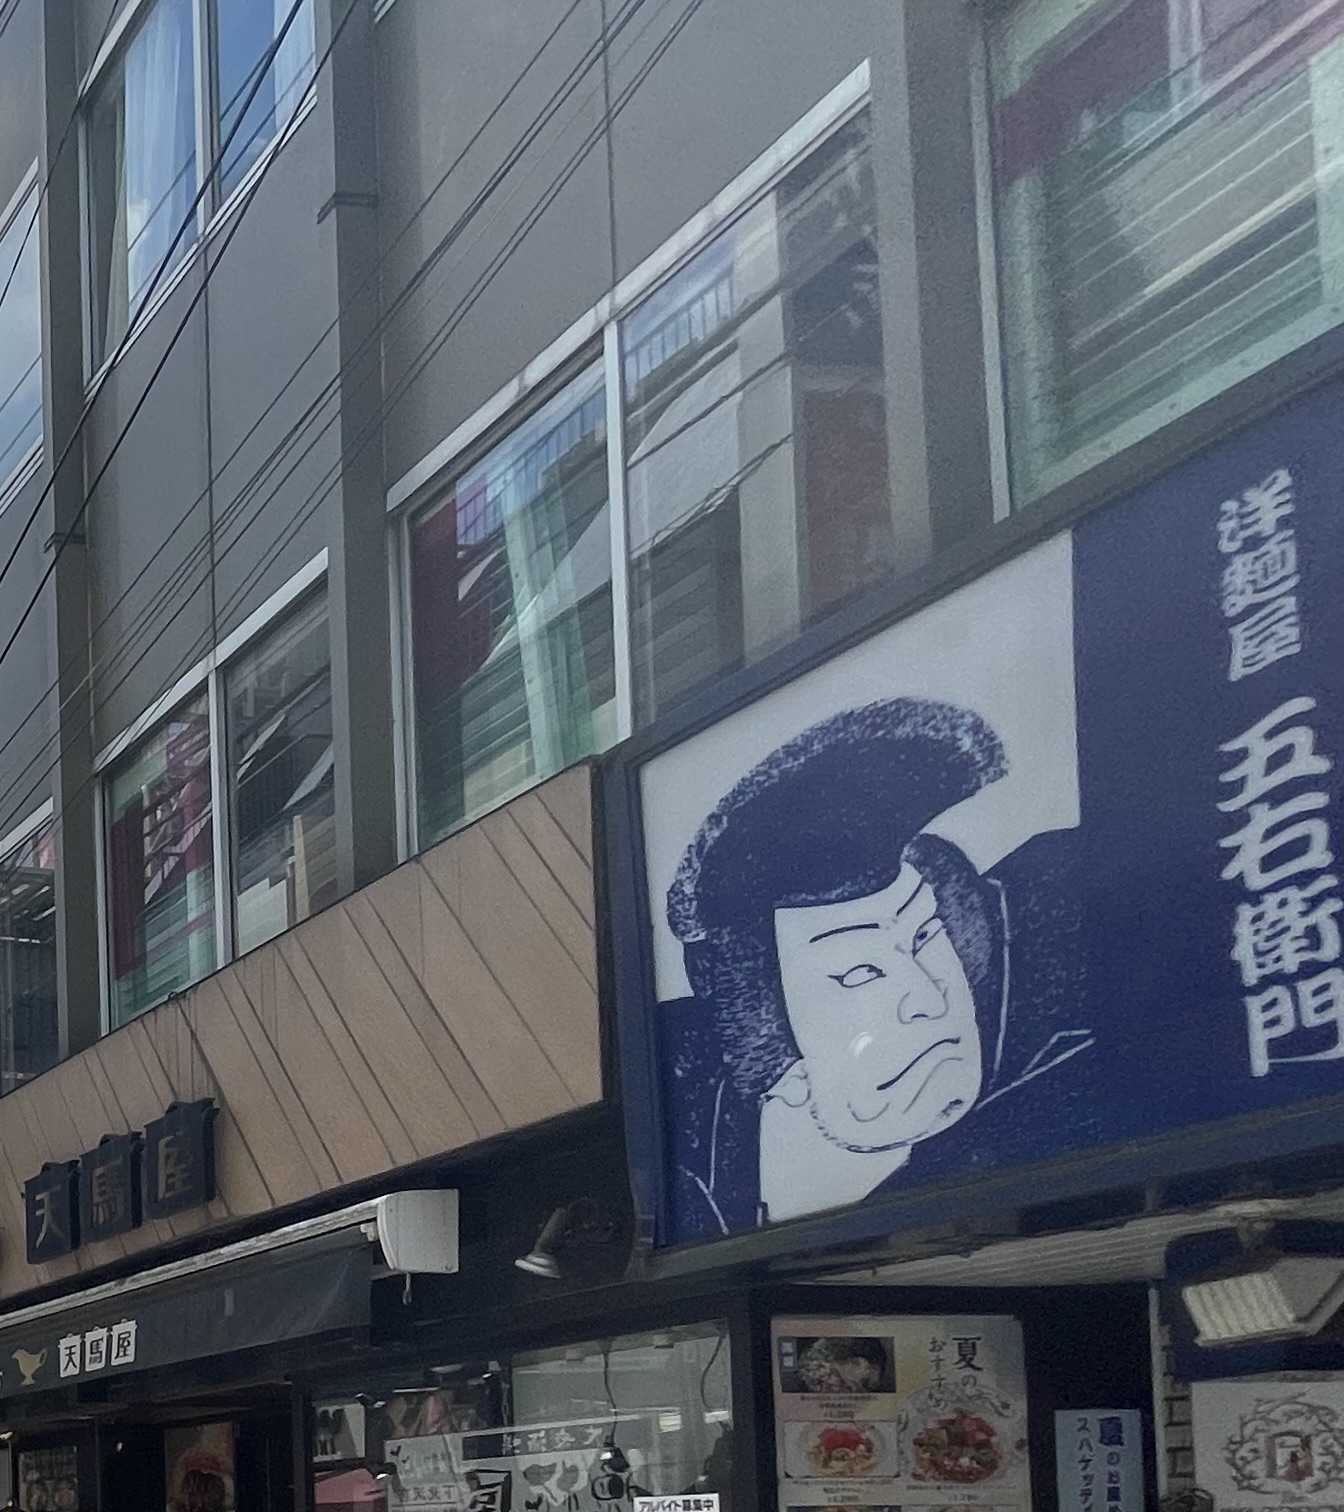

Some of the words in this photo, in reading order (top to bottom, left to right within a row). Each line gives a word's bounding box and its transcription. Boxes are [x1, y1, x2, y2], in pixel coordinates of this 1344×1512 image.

[1217, 696, 1344, 1079] 五右衛門
[33, 1133, 195, 1250] 天馬屋
[60, 1324, 135, 1374] 天馬屋
[952, 1335, 984, 1389] 夏の
